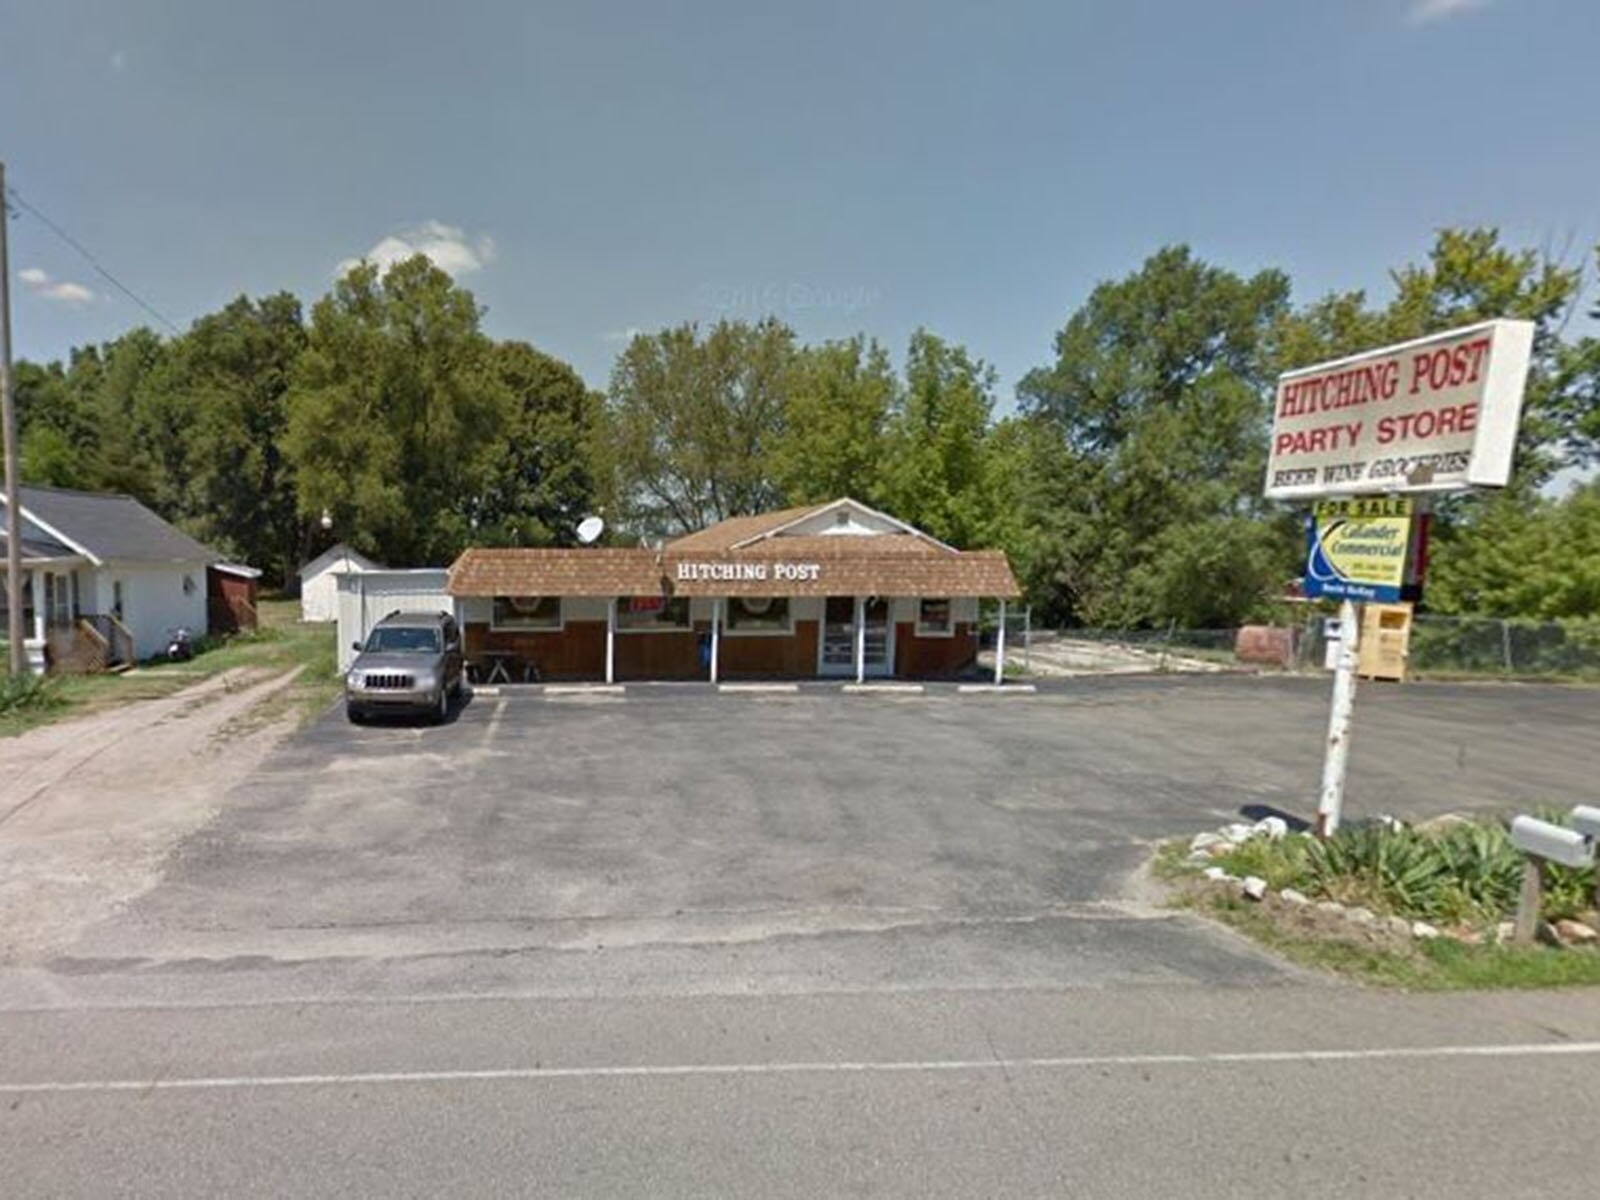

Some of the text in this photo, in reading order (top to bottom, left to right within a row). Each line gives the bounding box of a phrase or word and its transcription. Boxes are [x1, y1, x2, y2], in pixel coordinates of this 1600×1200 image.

[1279, 338, 1490, 418] HITCHING POST
[1275, 402, 1478, 455] PARTY STORE
[1272, 450, 1471, 488] BEER WINE GRORIES
[1317, 499, 1405, 515] FOR SALE
[677, 563, 820, 581] HITCHING POST
